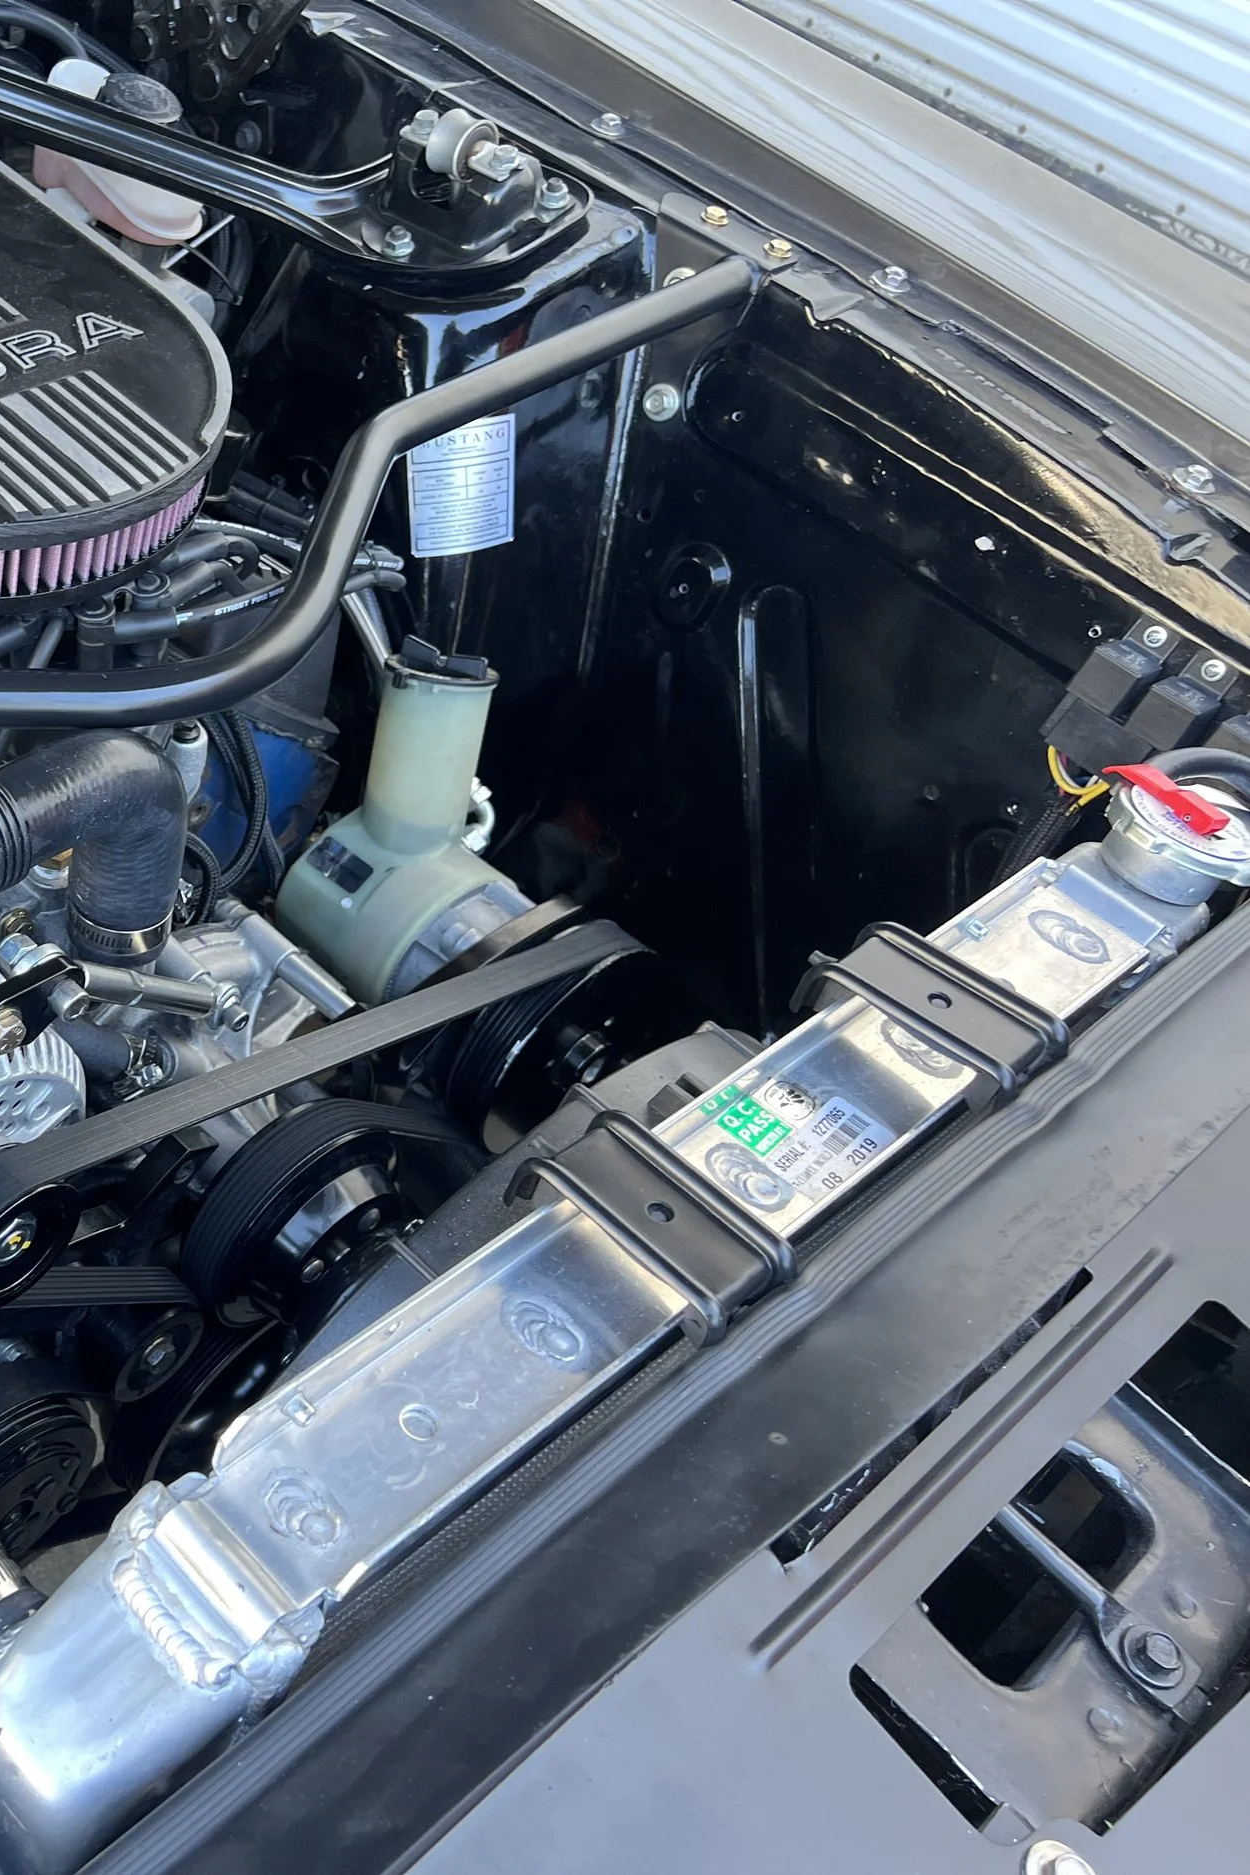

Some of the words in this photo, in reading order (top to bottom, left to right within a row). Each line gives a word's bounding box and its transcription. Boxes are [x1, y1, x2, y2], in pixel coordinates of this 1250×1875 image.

[738, 1109, 776, 1143] PASS
[774, 1142, 806, 1172] SERIAL
[811, 1106, 846, 1138] 1277065
[821, 1171, 843, 1190] 08
[846, 1137, 878, 1167] 2019
